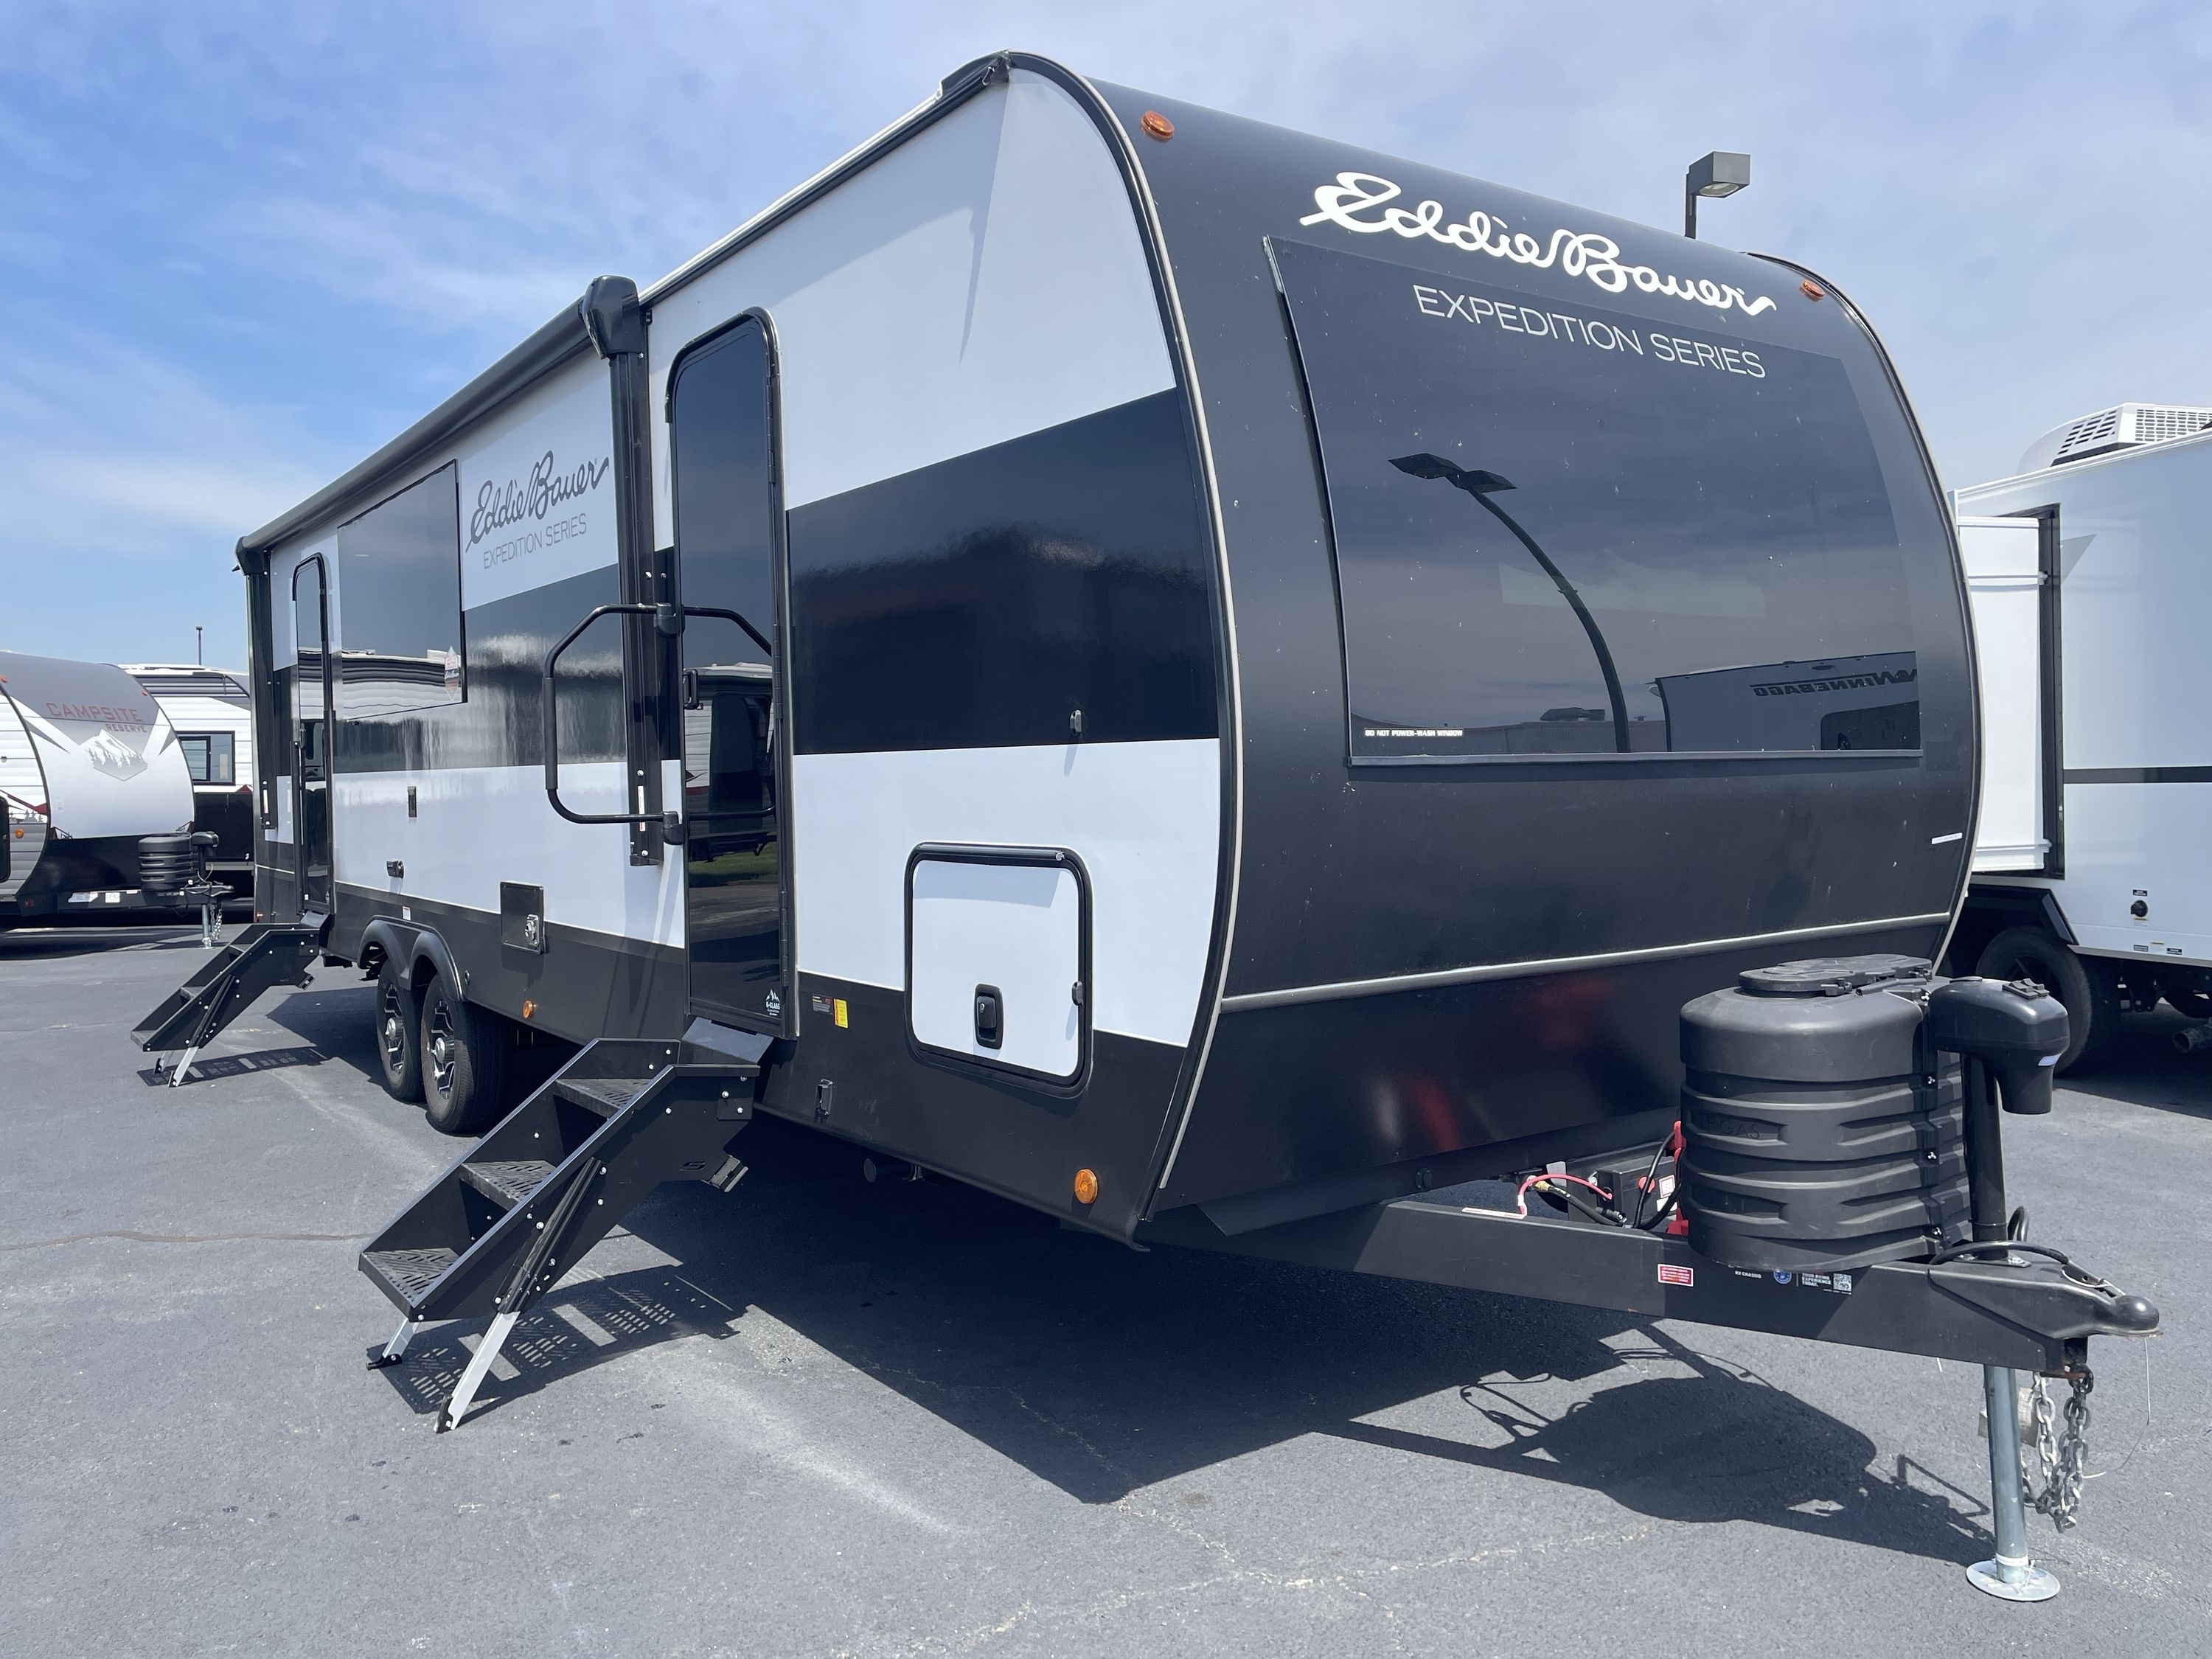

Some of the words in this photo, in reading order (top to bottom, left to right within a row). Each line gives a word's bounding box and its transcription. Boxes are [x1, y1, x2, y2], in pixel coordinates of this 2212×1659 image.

[1300, 172, 1548, 268] Eddie
[1548, 229, 1777, 316] Bauer
[1413, 285, 1644, 356] EXPEDITION
[1650, 333, 1765, 378] SERIES
[465, 480, 526, 553] Eddie
[525, 450, 609, 520] Bauer
[483, 530, 543, 570] EXPEDITION
[546, 512, 588, 547] SERIES
[46, 703, 143, 722] CAMPSITE
[105, 723, 147, 733] RESERVE
[1720, 1118, 1760, 1139] GAS
